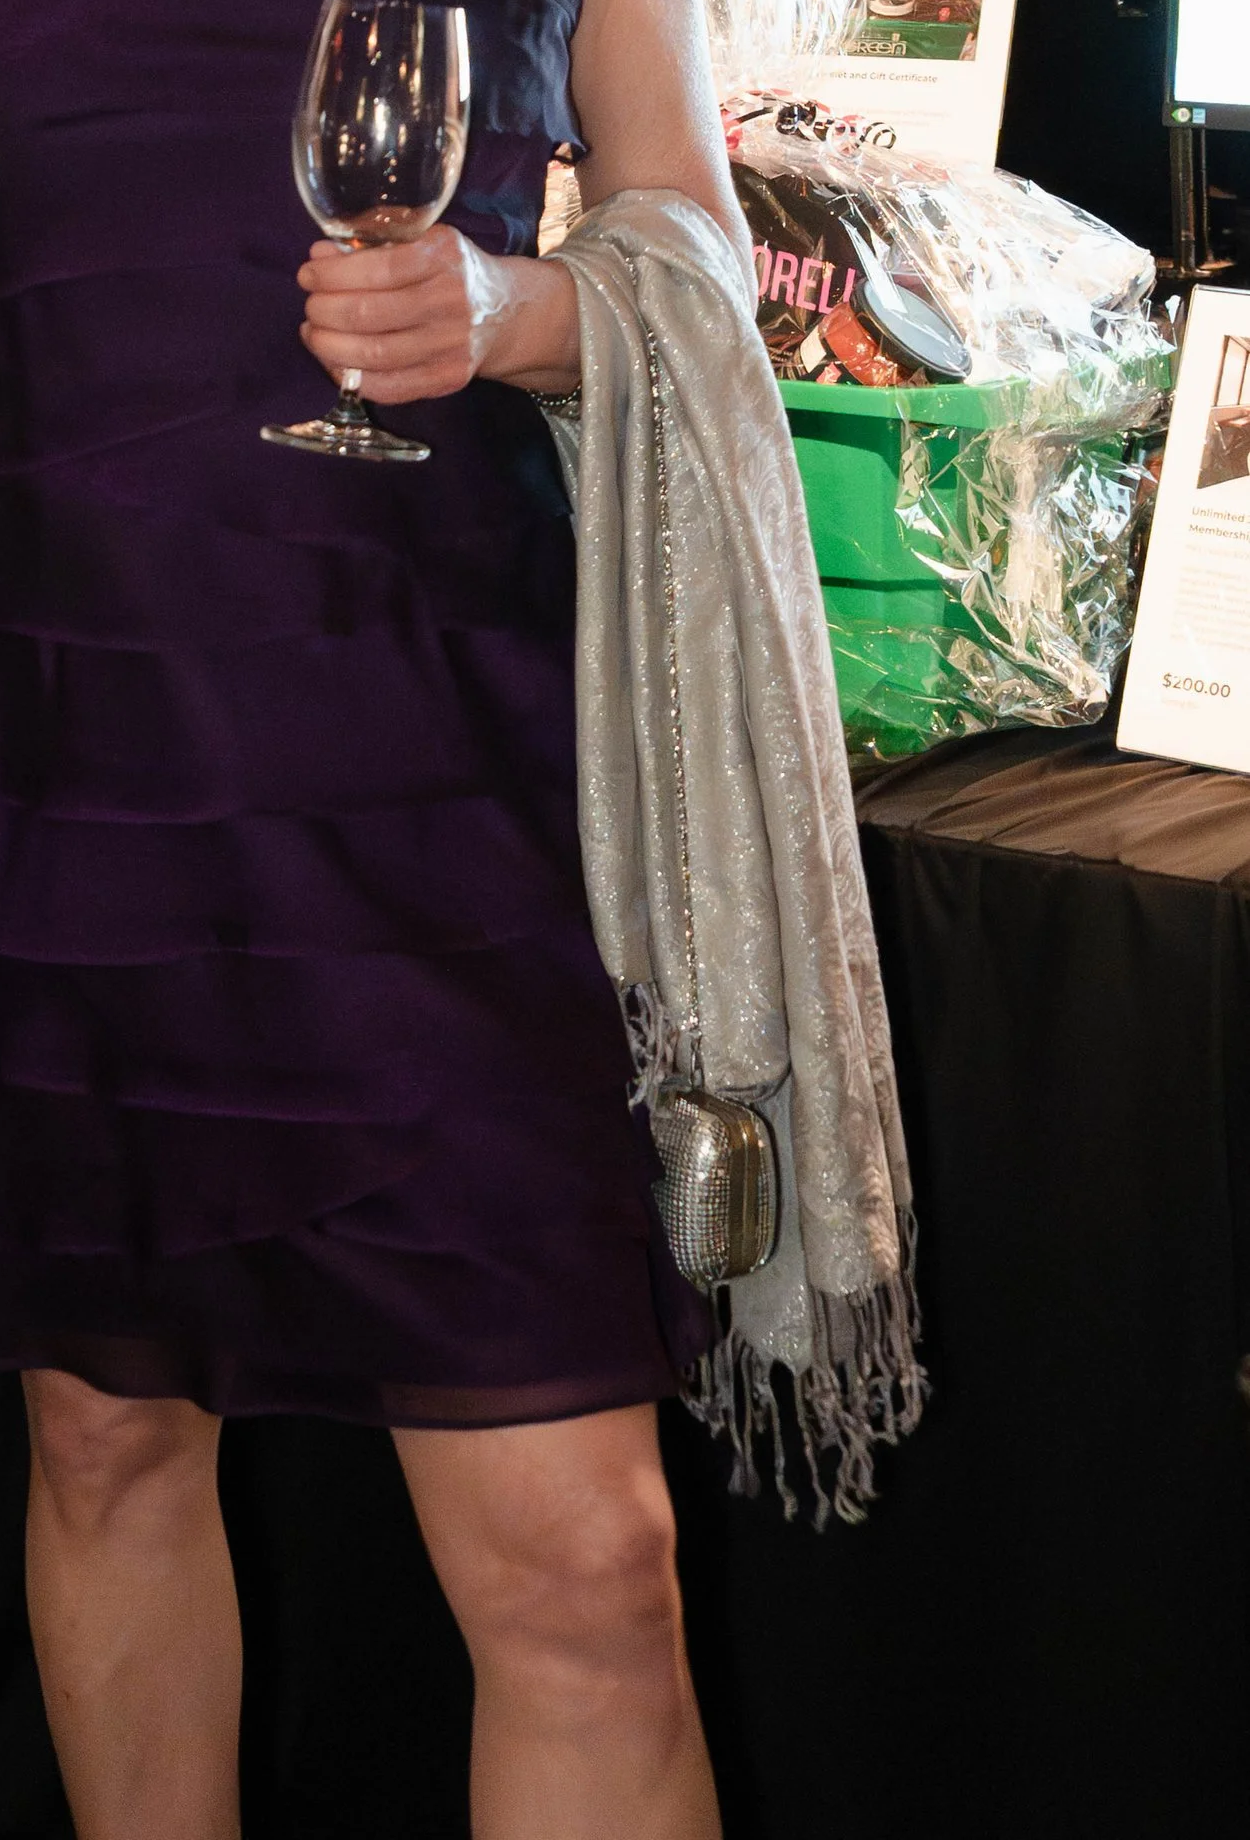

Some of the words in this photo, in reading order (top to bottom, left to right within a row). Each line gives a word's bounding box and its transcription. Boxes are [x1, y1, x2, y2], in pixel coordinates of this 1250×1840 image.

[849, 71, 868, 80] and
[869, 71, 886, 80] Gift
[888, 72, 939, 83] Certificate
[1192, 506, 1246, 523] Unlimited
[1189, 524, 1250, 544] Membershi
[1162, 672, 1231, 698] $200.00
